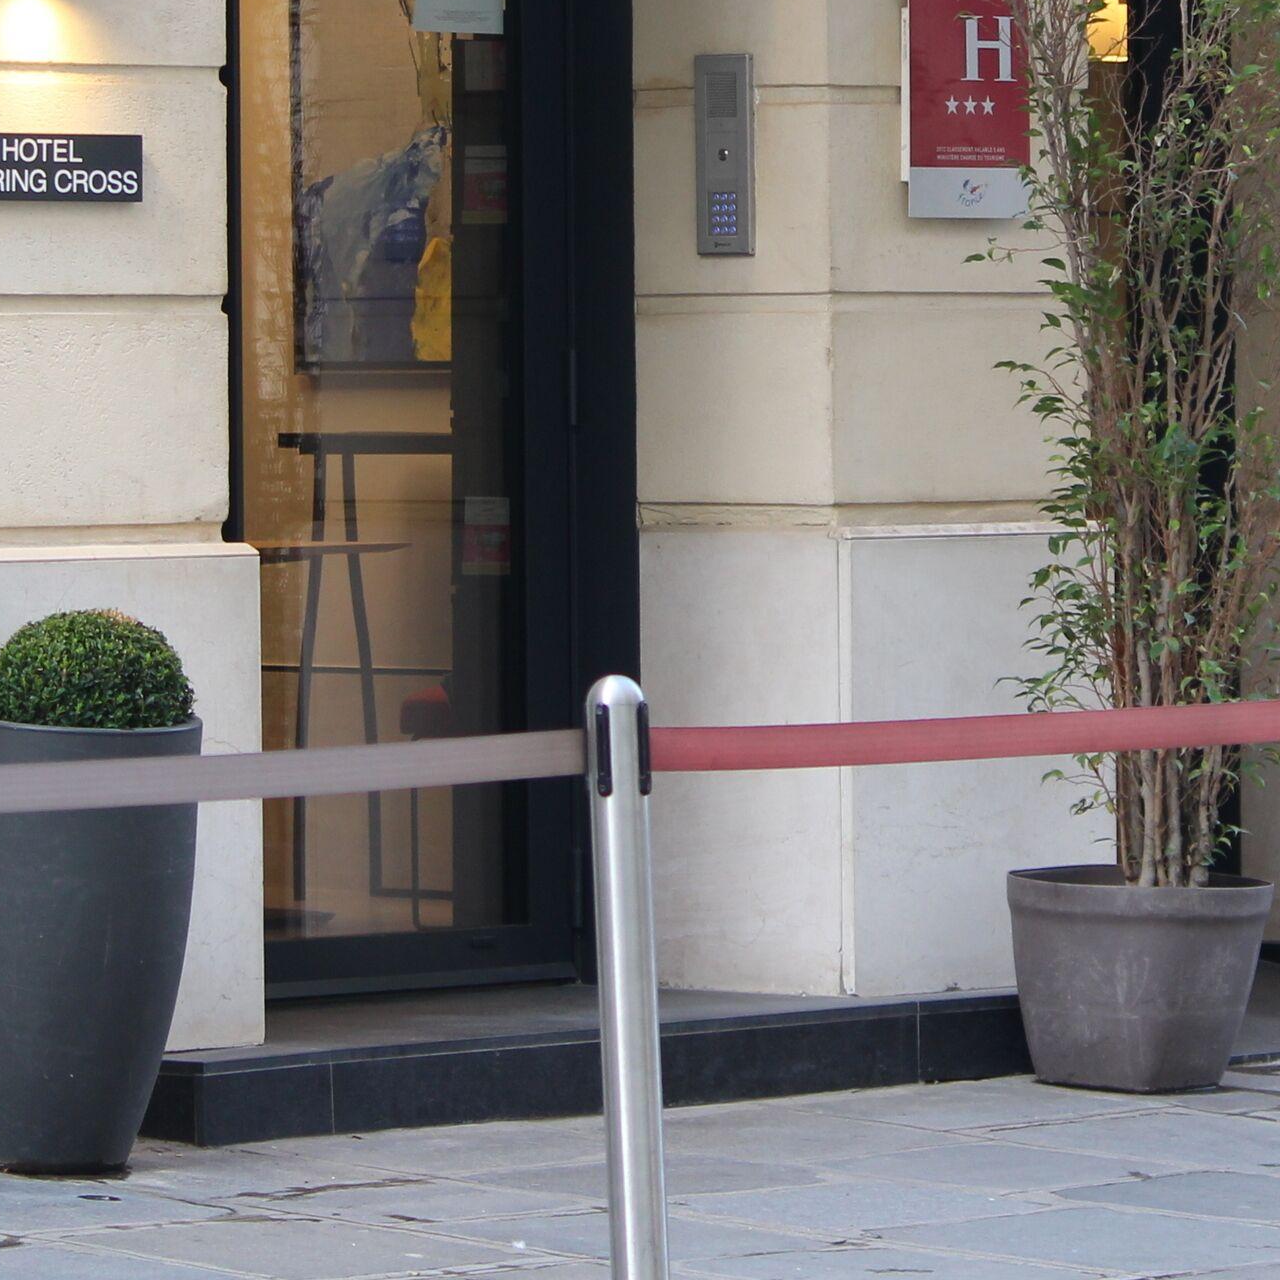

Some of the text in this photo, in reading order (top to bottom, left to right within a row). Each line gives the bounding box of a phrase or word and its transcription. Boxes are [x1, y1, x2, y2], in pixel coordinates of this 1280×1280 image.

[959, 15, 1017, 82] H
[2, 138, 83, 163] HOTEL
[54, 169, 139, 195] CROSS
